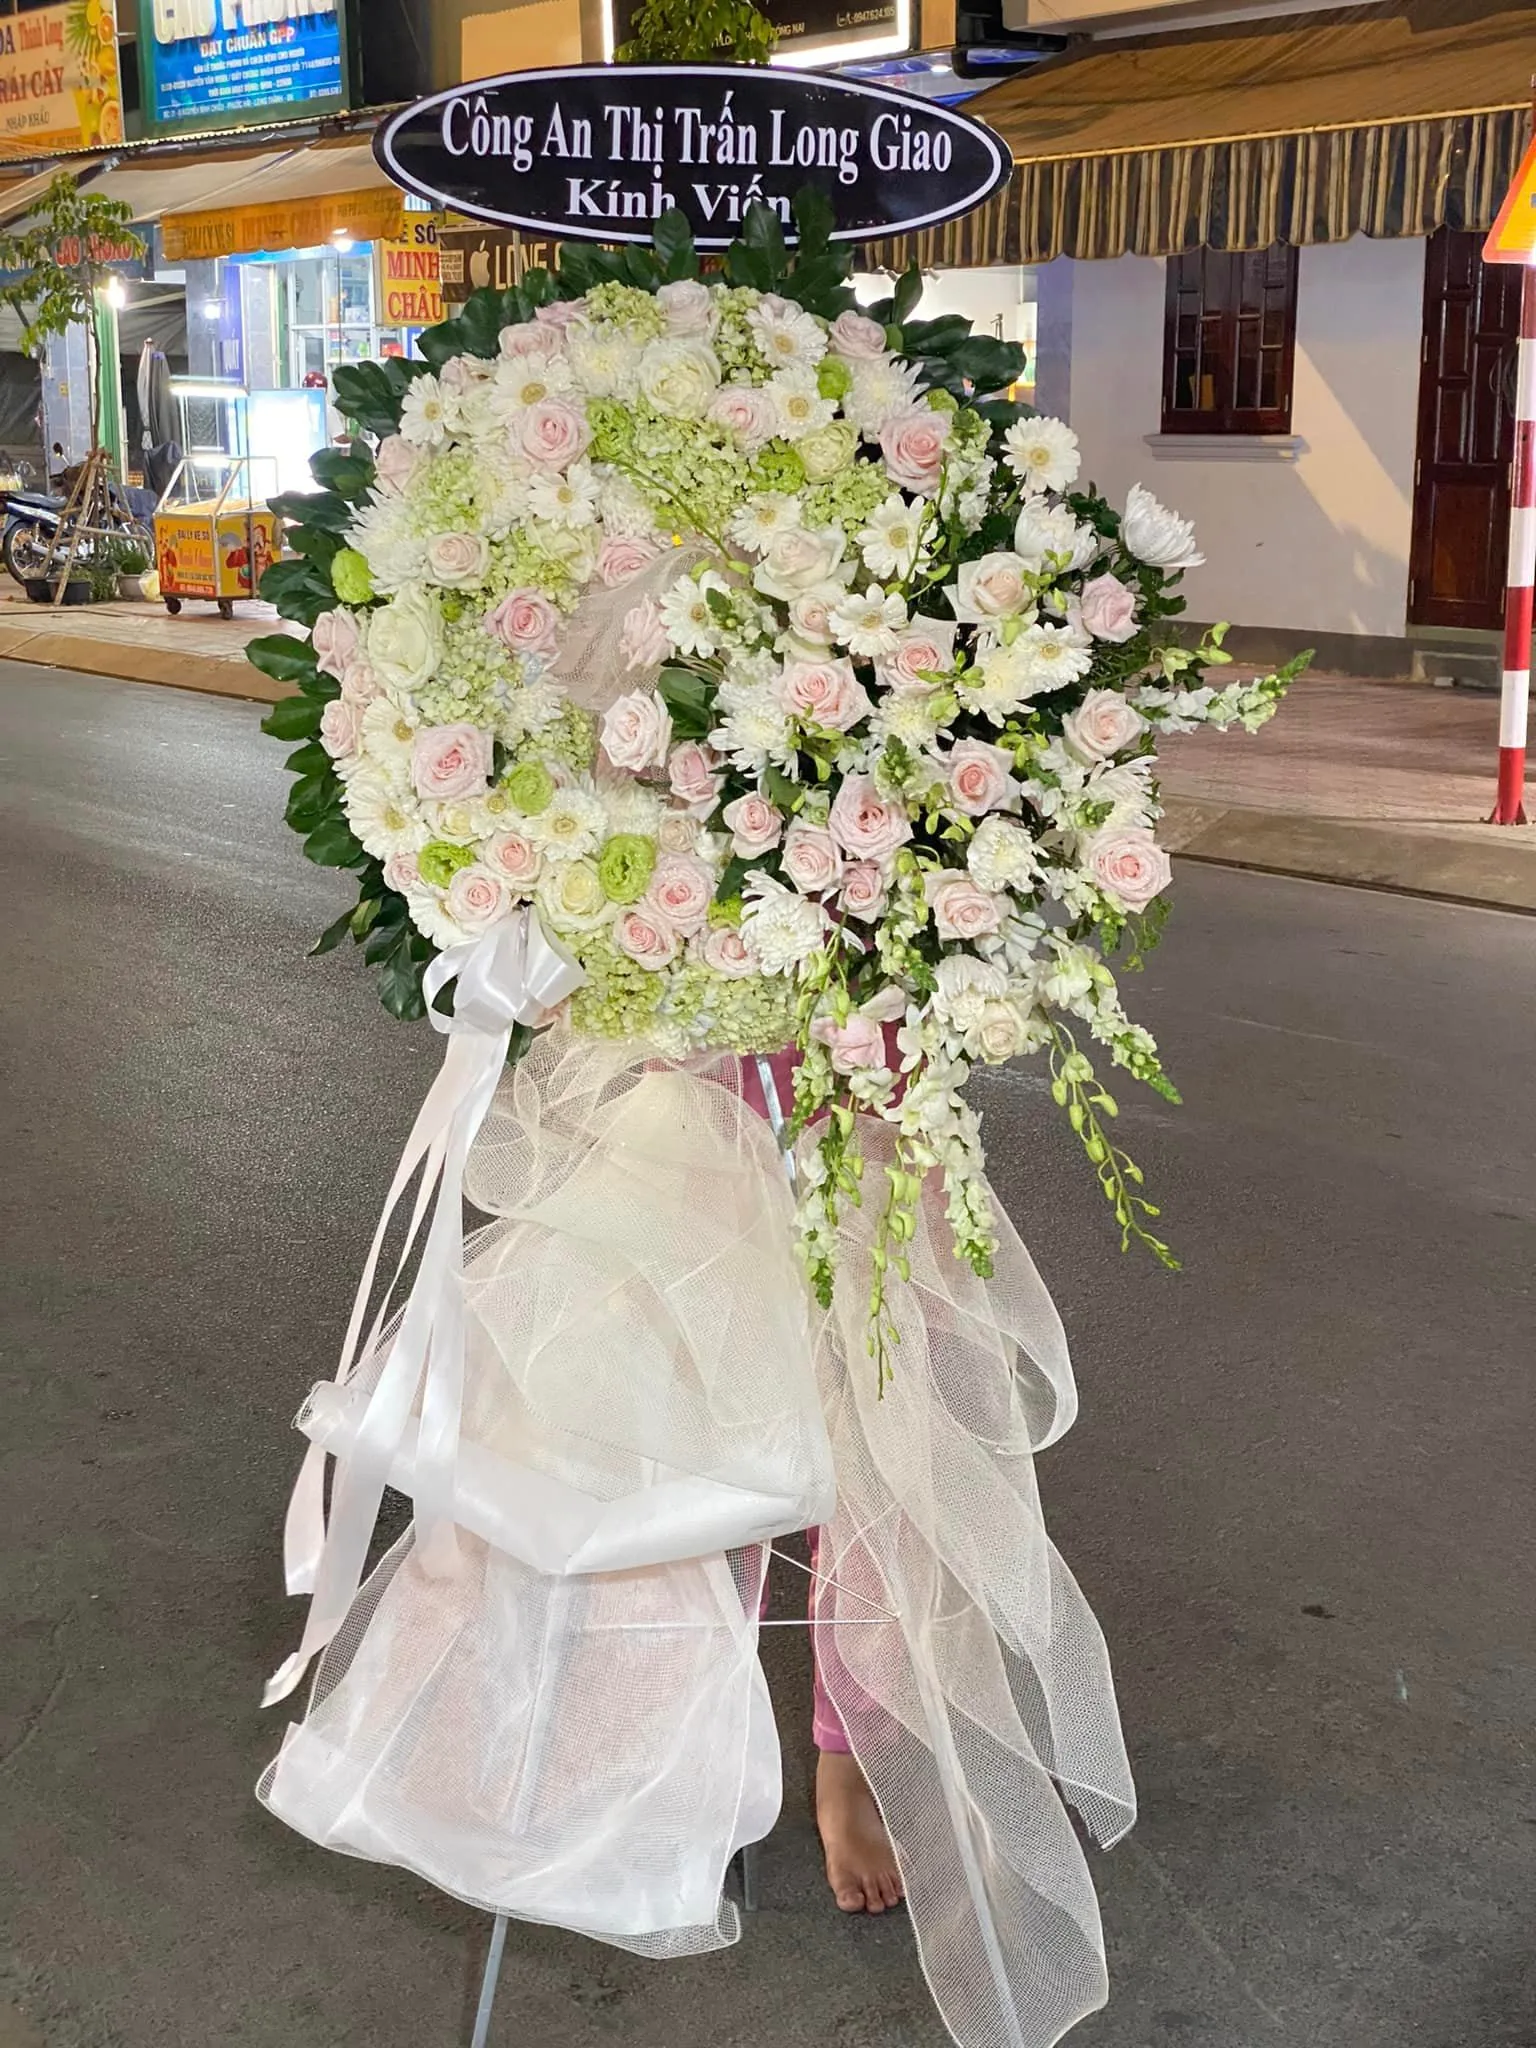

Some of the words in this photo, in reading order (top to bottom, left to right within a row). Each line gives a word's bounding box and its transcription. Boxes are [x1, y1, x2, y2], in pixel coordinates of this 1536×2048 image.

[442, 95, 534, 173] Công
[541, 101, 593, 159] An
[604, 105, 665, 179] Thị
[674, 90, 758, 164] Trấn
[768, 109, 860, 185] Long
[869, 113, 952, 172] Giao
[565, 177, 676, 219] Kính
[691, 173, 796, 225] Viến
[414, 216, 439, 245] SỐ
[387, 250, 440, 281] MINH
[388, 285, 443, 321] CHÂU
